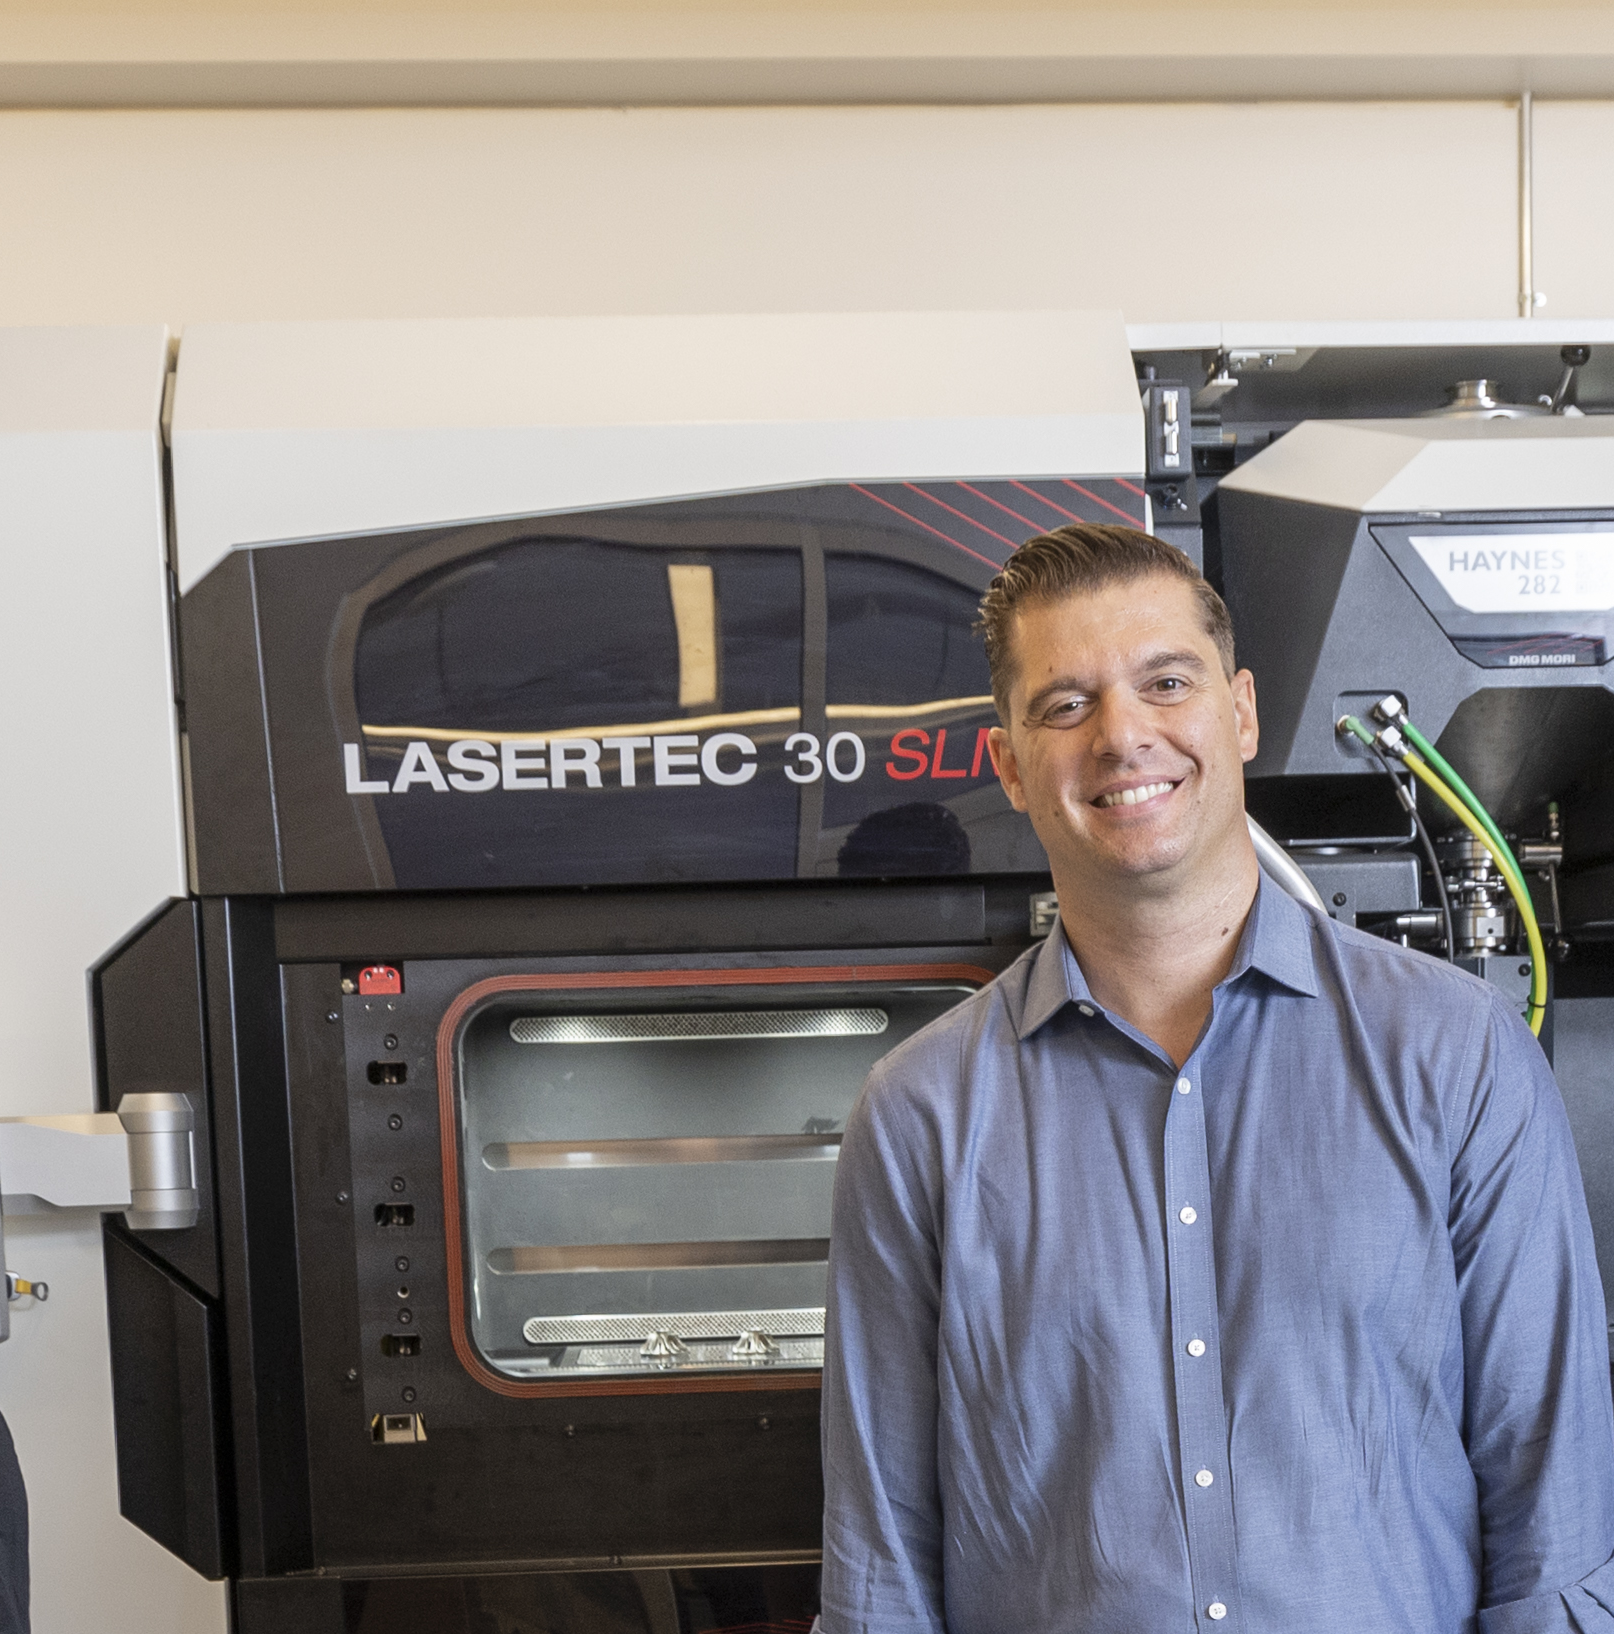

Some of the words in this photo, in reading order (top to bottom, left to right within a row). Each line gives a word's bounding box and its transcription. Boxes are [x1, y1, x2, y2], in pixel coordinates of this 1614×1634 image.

[1449, 550, 1566, 571] HAYNES
[1518, 574, 1562, 595] 282
[1509, 655, 1540, 665] DMG
[1541, 654, 1576, 664] MORI
[343, 733, 757, 794] LASERTEC
[783, 731, 866, 783] 30
